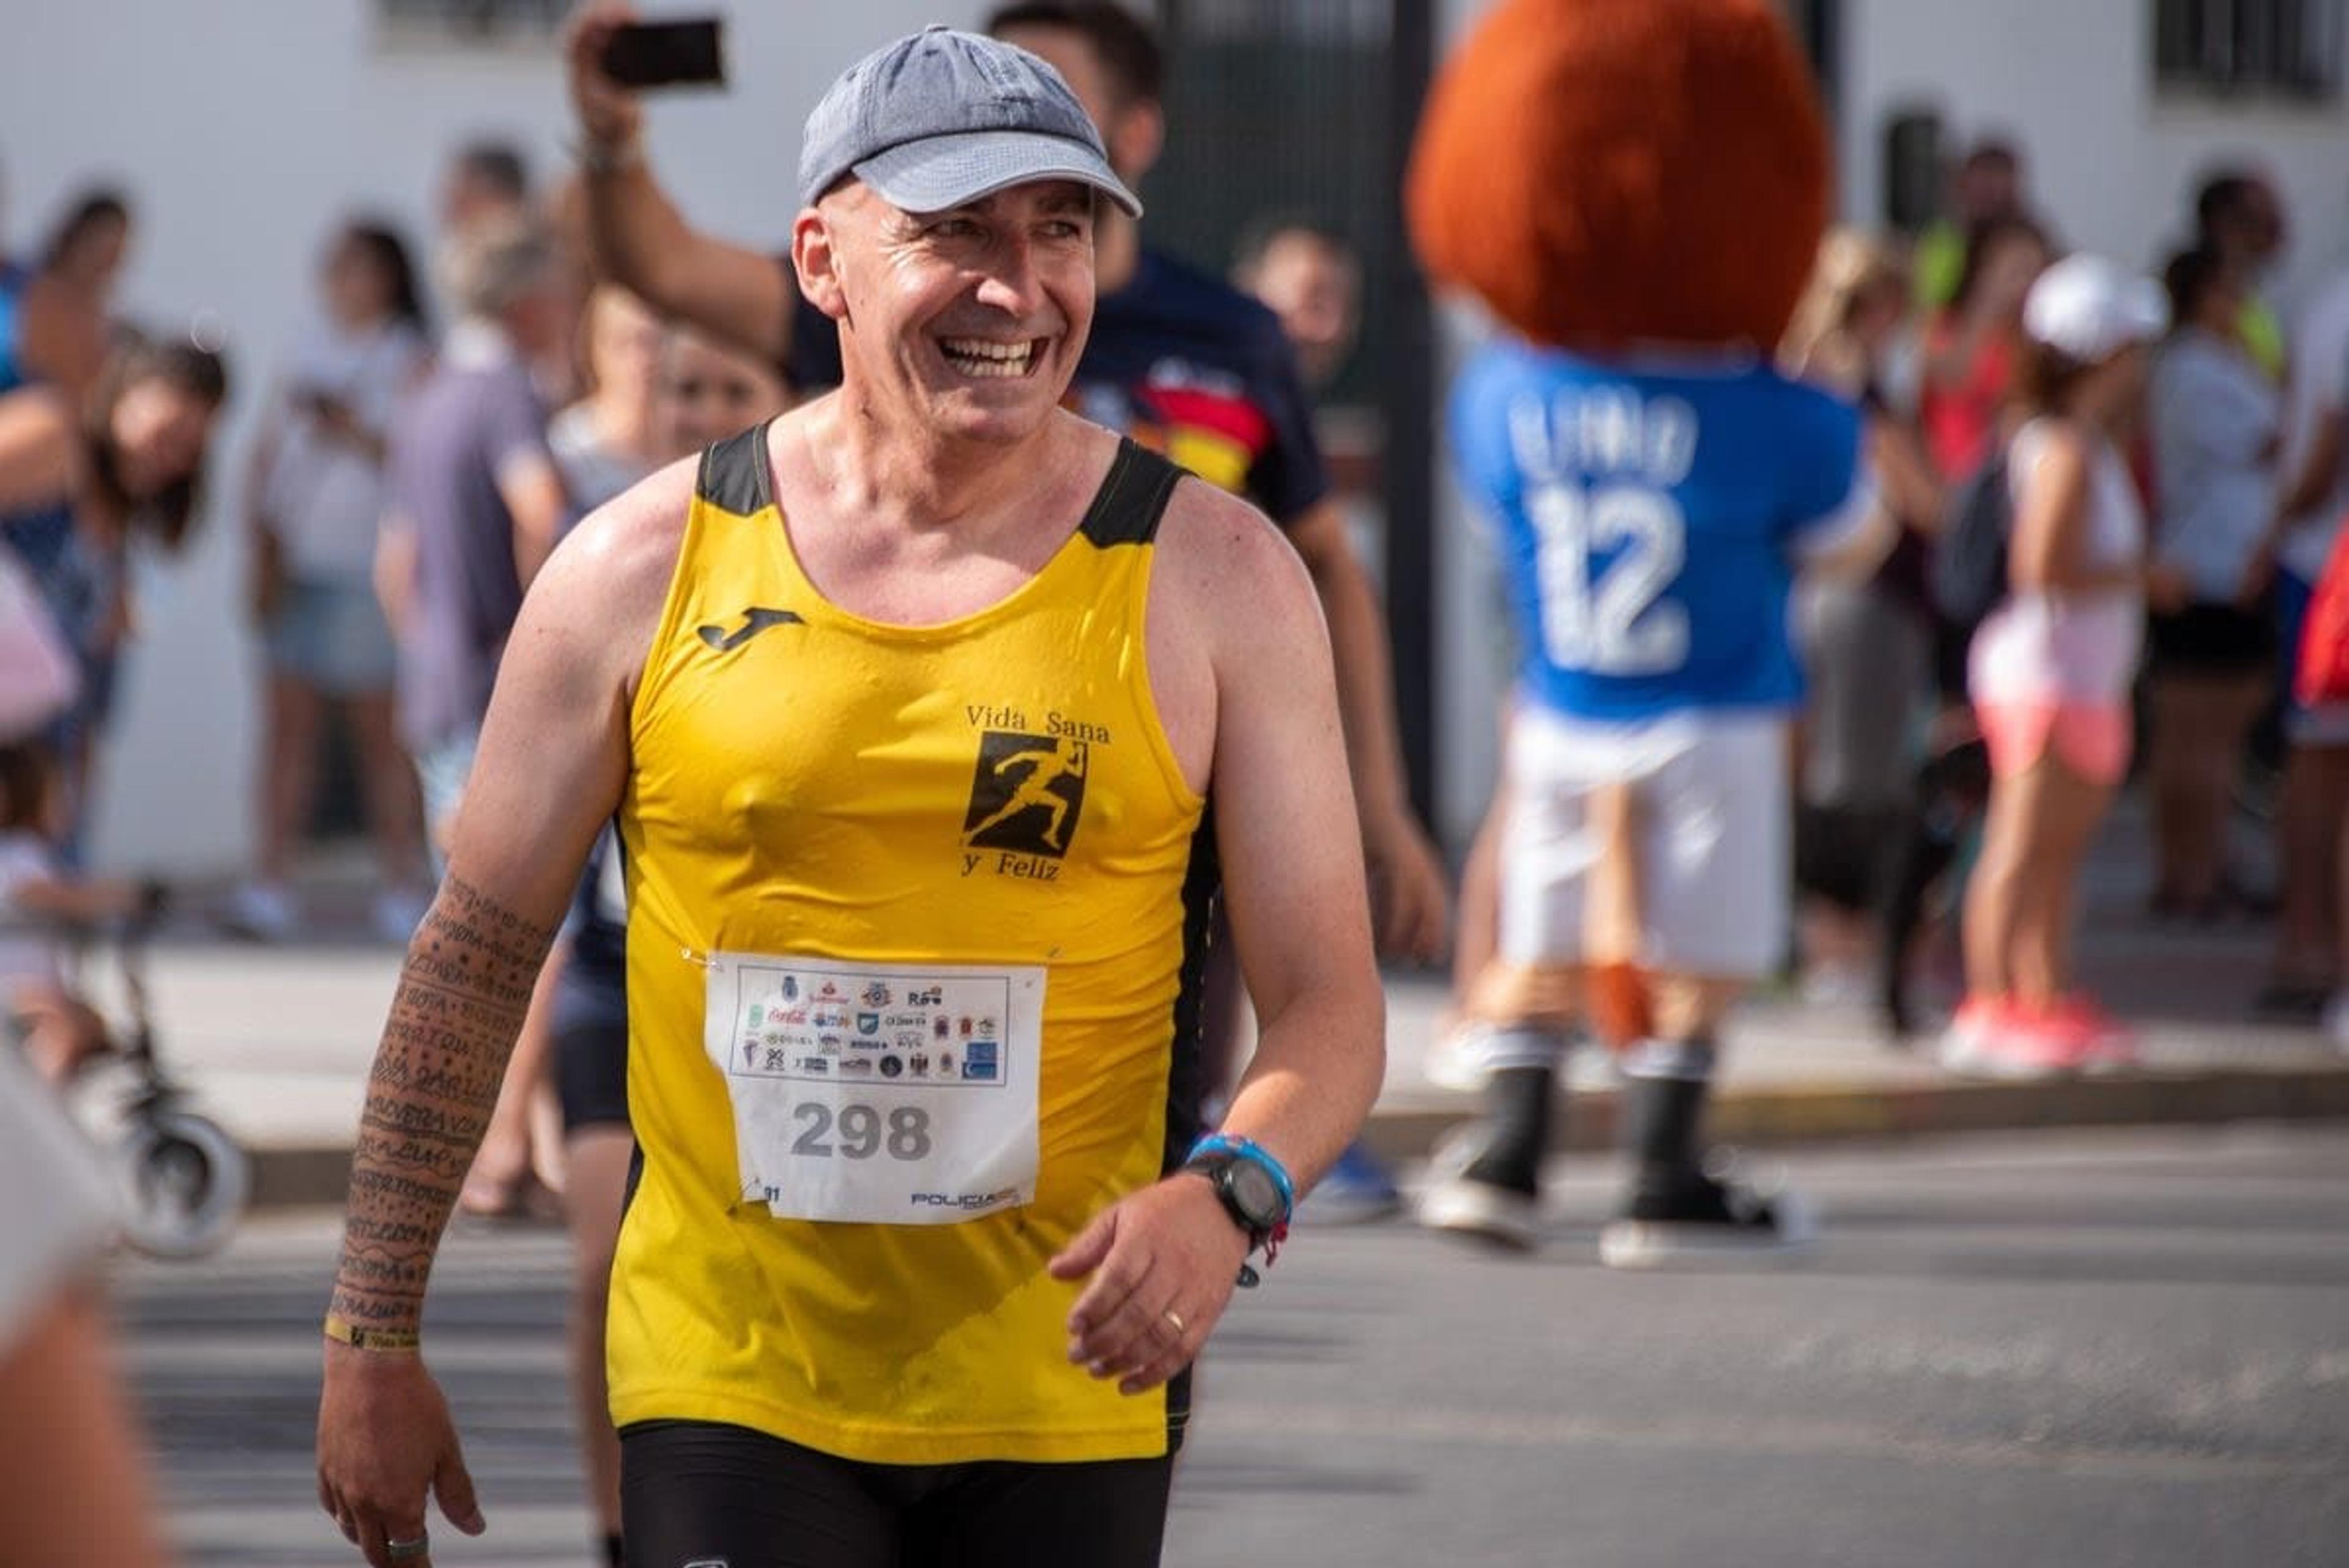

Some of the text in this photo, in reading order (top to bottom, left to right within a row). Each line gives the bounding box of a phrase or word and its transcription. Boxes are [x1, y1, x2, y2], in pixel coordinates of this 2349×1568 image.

[1529, 487, 1691, 676] 12
[967, 706, 1110, 744] Vida Sana
[961, 852, 1059, 881] y Feliz
[790, 1102, 931, 1161] 298
